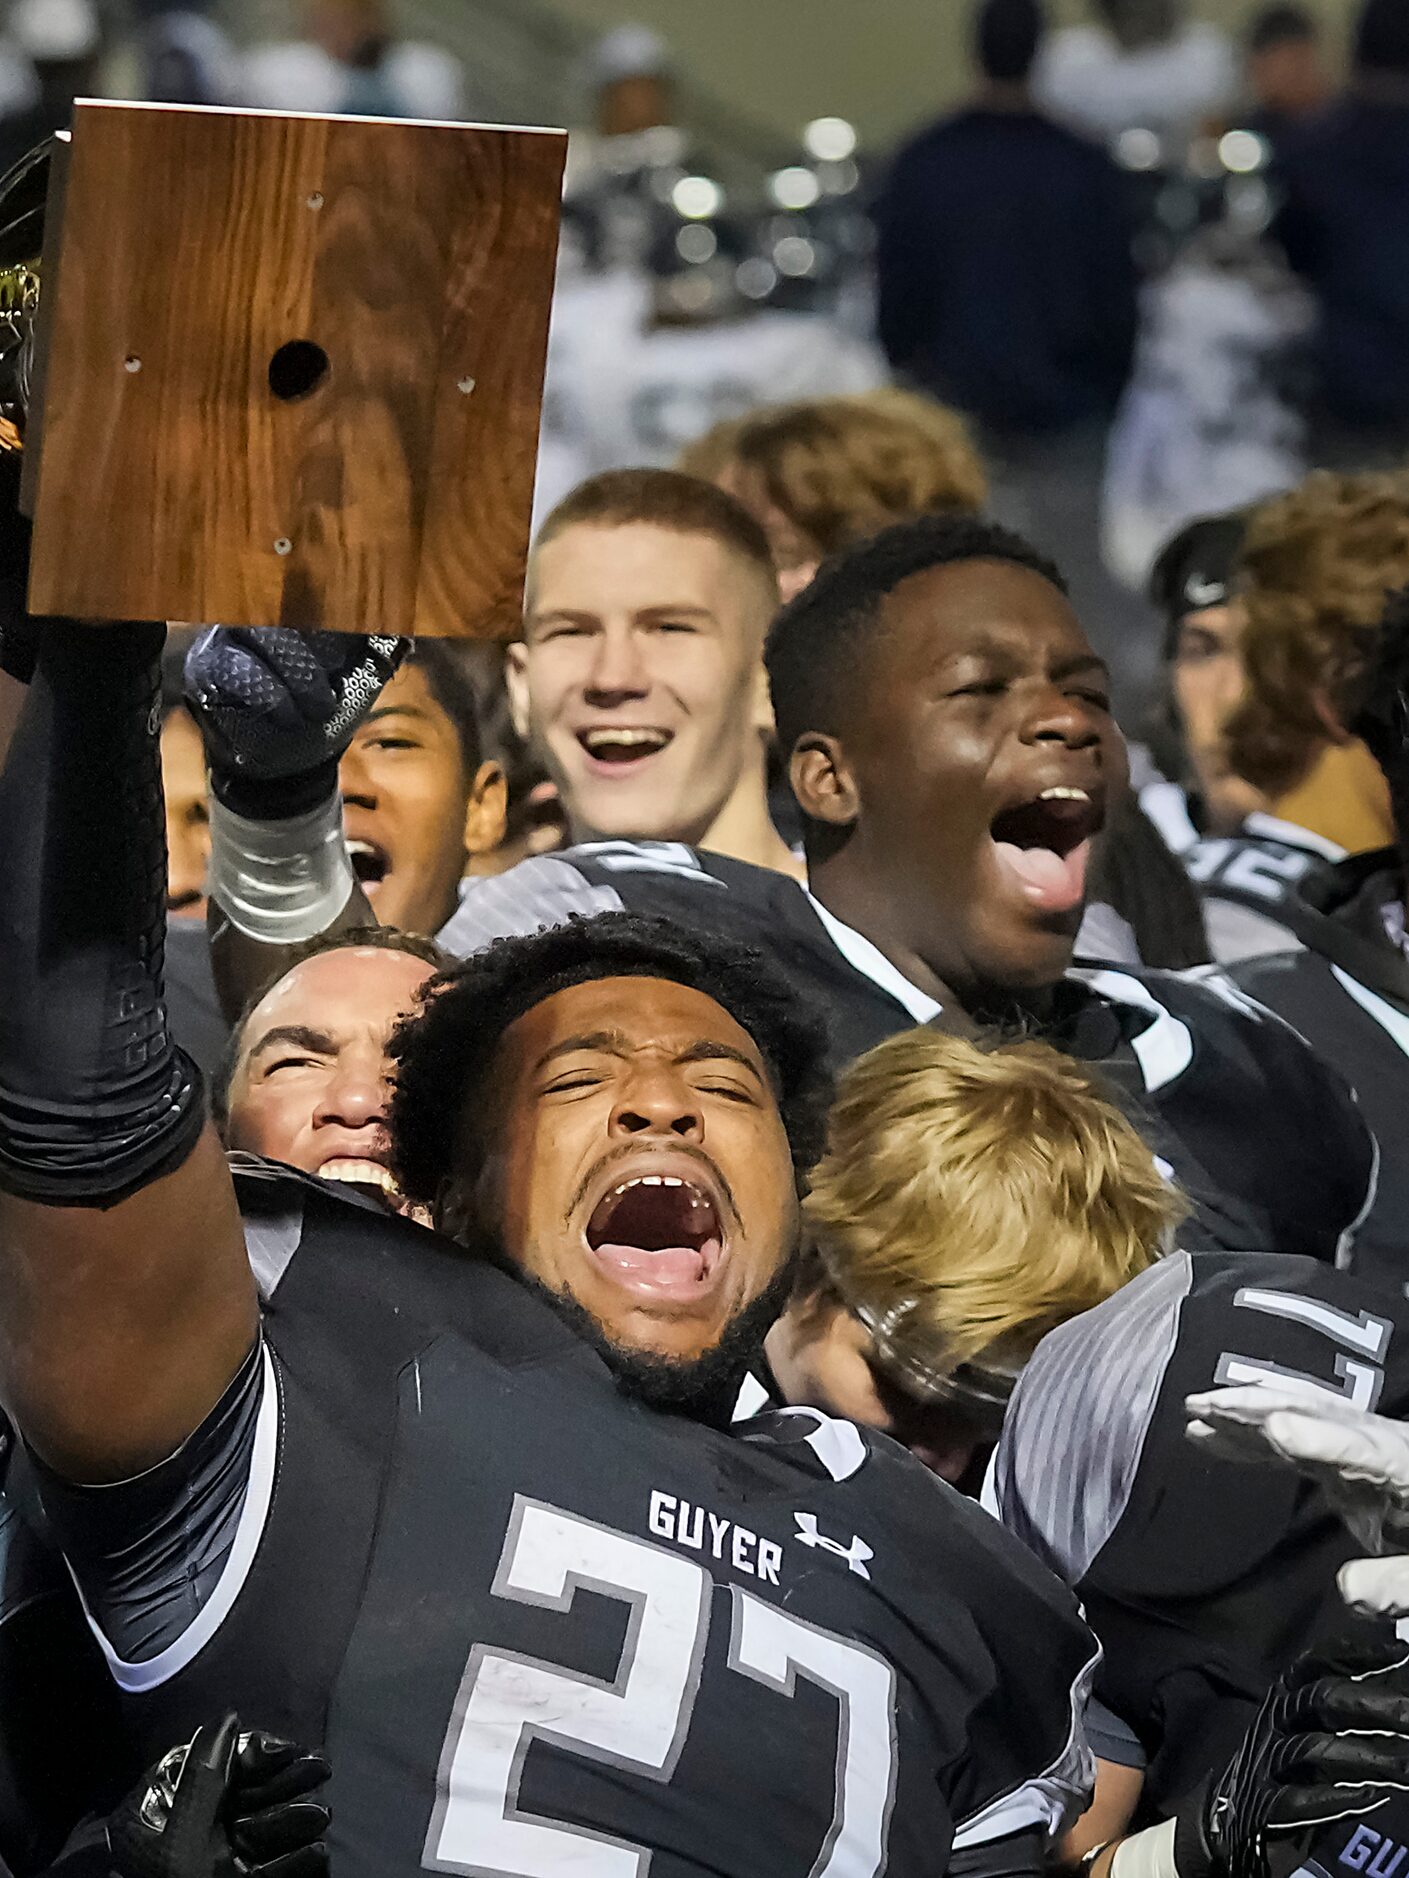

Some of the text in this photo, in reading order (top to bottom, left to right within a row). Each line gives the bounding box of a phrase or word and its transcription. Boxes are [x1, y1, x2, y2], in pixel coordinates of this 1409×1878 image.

[649, 1489, 783, 1586] GUYER
[420, 1492, 899, 1878] 27
[1338, 1823, 1409, 1878] GU
